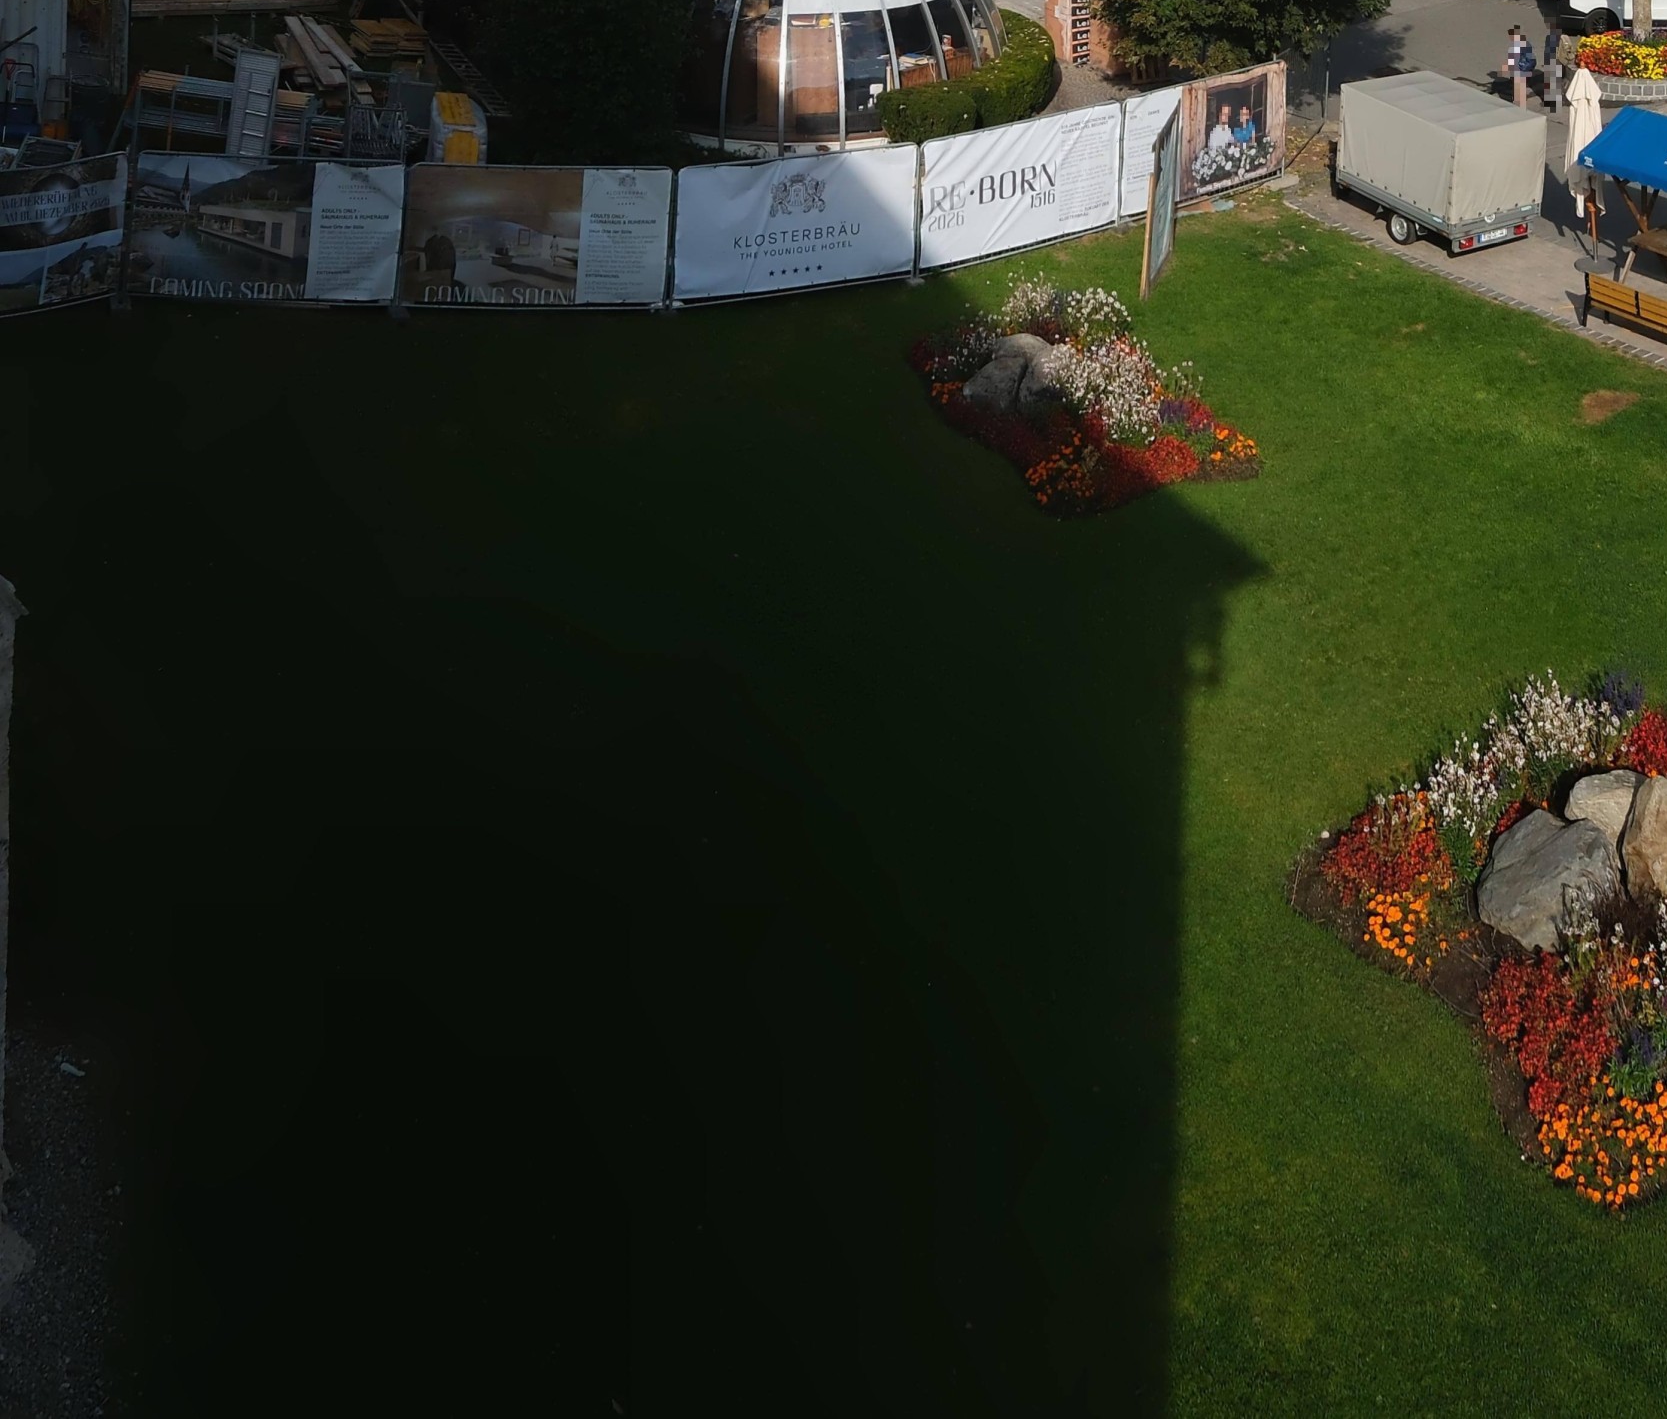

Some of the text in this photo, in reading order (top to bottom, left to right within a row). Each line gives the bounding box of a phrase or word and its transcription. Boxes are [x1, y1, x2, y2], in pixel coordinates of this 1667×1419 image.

[1030, 189, 1055, 209] 1516
[928, 211, 965, 232] 2026
[733, 221, 860, 250] KLOSTERBRÄU
[739, 240, 853, 260] THE YOUNIQUE HOTEL
[150, 277, 233, 298] COMING
[240, 280, 304, 300] SOON!
[424, 285, 504, 304] COMING
[512, 286, 574, 305] SOON!
